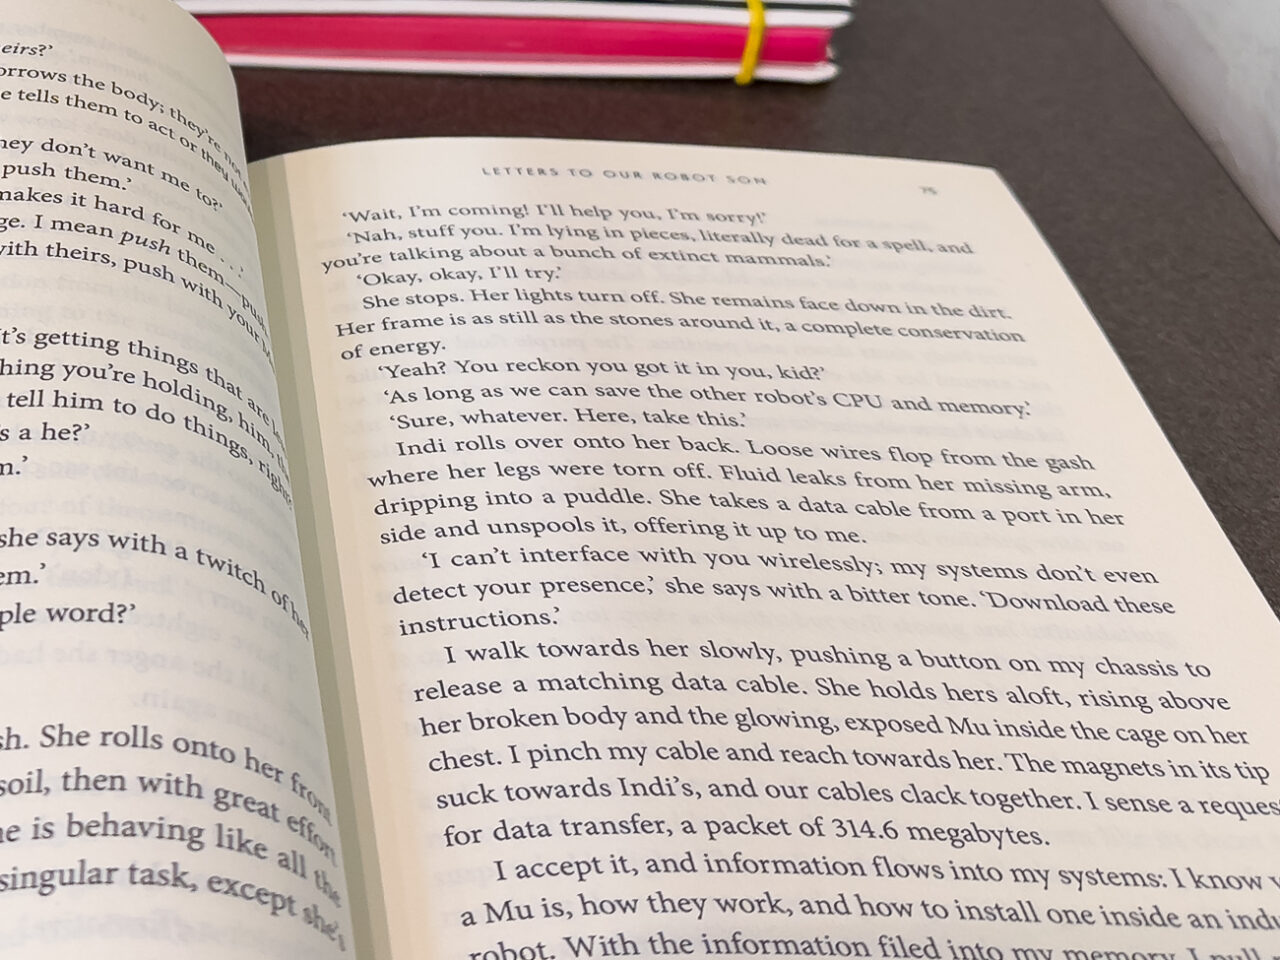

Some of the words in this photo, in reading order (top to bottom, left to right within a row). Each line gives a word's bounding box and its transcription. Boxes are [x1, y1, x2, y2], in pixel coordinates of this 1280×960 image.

[0, 161, 56, 180] push
[64, 165, 132, 191] them.’
[40, 137, 96, 159] don’t
[102, 151, 155, 176] want
[160, 170, 190, 193] me
[481, 166, 559, 177] LETTERS
[568, 168, 593, 178] TO
[603, 169, 643, 180] OUR
[652, 171, 716, 183] ROBOT
[725, 175, 769, 186] SON
[341, 208, 403, 223] ‘Wait,
[408, 204, 442, 218] I’m
[447, 203, 530, 220] coming!
[535, 203, 565, 217] I’ll
[568, 203, 613, 222] help
[618, 208, 663, 222] you,
[666, 207, 701, 222] I’m
[705, 211, 766, 227] sorry!’
[320, 251, 383, 275] you’re
[388, 246, 465, 262] talking
[468, 244, 528, 258] about
[532, 248, 546, 258] a
[548, 244, 617, 259] bunch
[621, 246, 643, 261] of
[647, 249, 720, 263] extinct
[724, 253, 832, 268] mammals.’
[356, 271, 423, 287] ‘Okay,
[428, 267, 484, 284] okay,
[488, 265, 519, 279] I’ll
[524, 265, 562, 283] try.’
[340, 343, 364, 361] of
[368, 340, 447, 357] energy.
[377, 360, 447, 379] ‘Yeah?
[453, 359, 500, 374] You
[505, 356, 581, 373] reckon
[585, 361, 629, 377] you
[633, 361, 670, 378] got
[673, 360, 692, 375] it
[695, 361, 721, 377] in
[724, 366, 774, 381] you,
[775, 363, 825, 381] kid?’
[18, 427, 33, 441] a
[40, 421, 91, 442] he?’
[389, 414, 455, 430] ‘Sure,
[459, 408, 568, 425] whatever.
[573, 407, 637, 425] Here,
[642, 408, 691, 425] take
[695, 410, 746, 428] this.’
[380, 524, 427, 545] side
[433, 518, 481, 539] and
[486, 515, 596, 539] unspools
[601, 516, 628, 535] it,
[633, 516, 730, 542] offering
[732, 520, 752, 538] it
[756, 526, 788, 544] up
[793, 525, 818, 542] to
[823, 530, 867, 544] me.
[399, 606, 560, 637] instructions.’
[413, 679, 503, 703] release
[512, 679, 529, 693] a
[536, 670, 665, 697] matching
[671, 671, 728, 692] data
[735, 673, 808, 696] cable.
[814, 676, 862, 698] She
[865, 678, 938, 701] holds
[941, 681, 999, 703] hers
[1005, 684, 1072, 709] aloft,
[1077, 688, 1154, 715] rising
[1157, 690, 1232, 711] above
[443, 824, 483, 848] for
[492, 818, 553, 842] data
[559, 812, 674, 838] transfer,
[680, 819, 698, 835] a
[703, 813, 793, 842] packet
[798, 815, 826, 838] of
[831, 818, 899, 840] 314.6
[905, 821, 1051, 851] megabytes.
